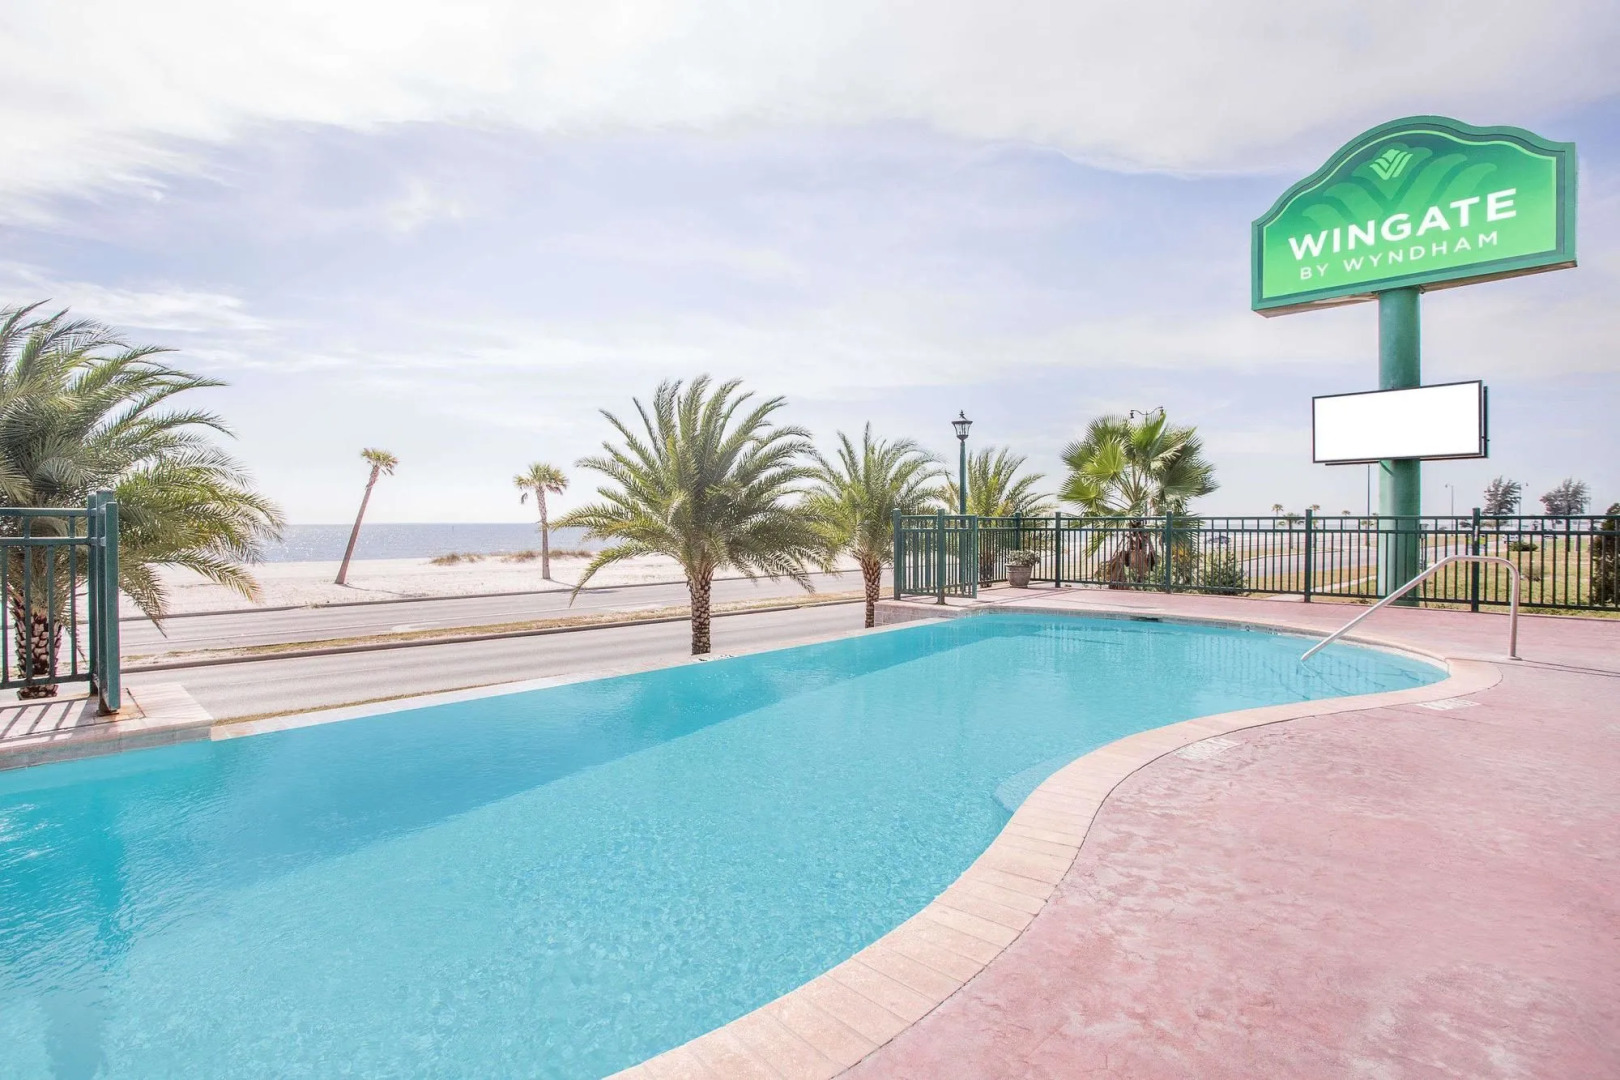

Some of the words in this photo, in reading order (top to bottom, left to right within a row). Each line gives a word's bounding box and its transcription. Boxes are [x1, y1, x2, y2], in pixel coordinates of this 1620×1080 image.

[1288, 188, 1517, 261] WINGATE
[1300, 263, 1329, 280] BY
[1343, 230, 1498, 272] WYNDHAM
